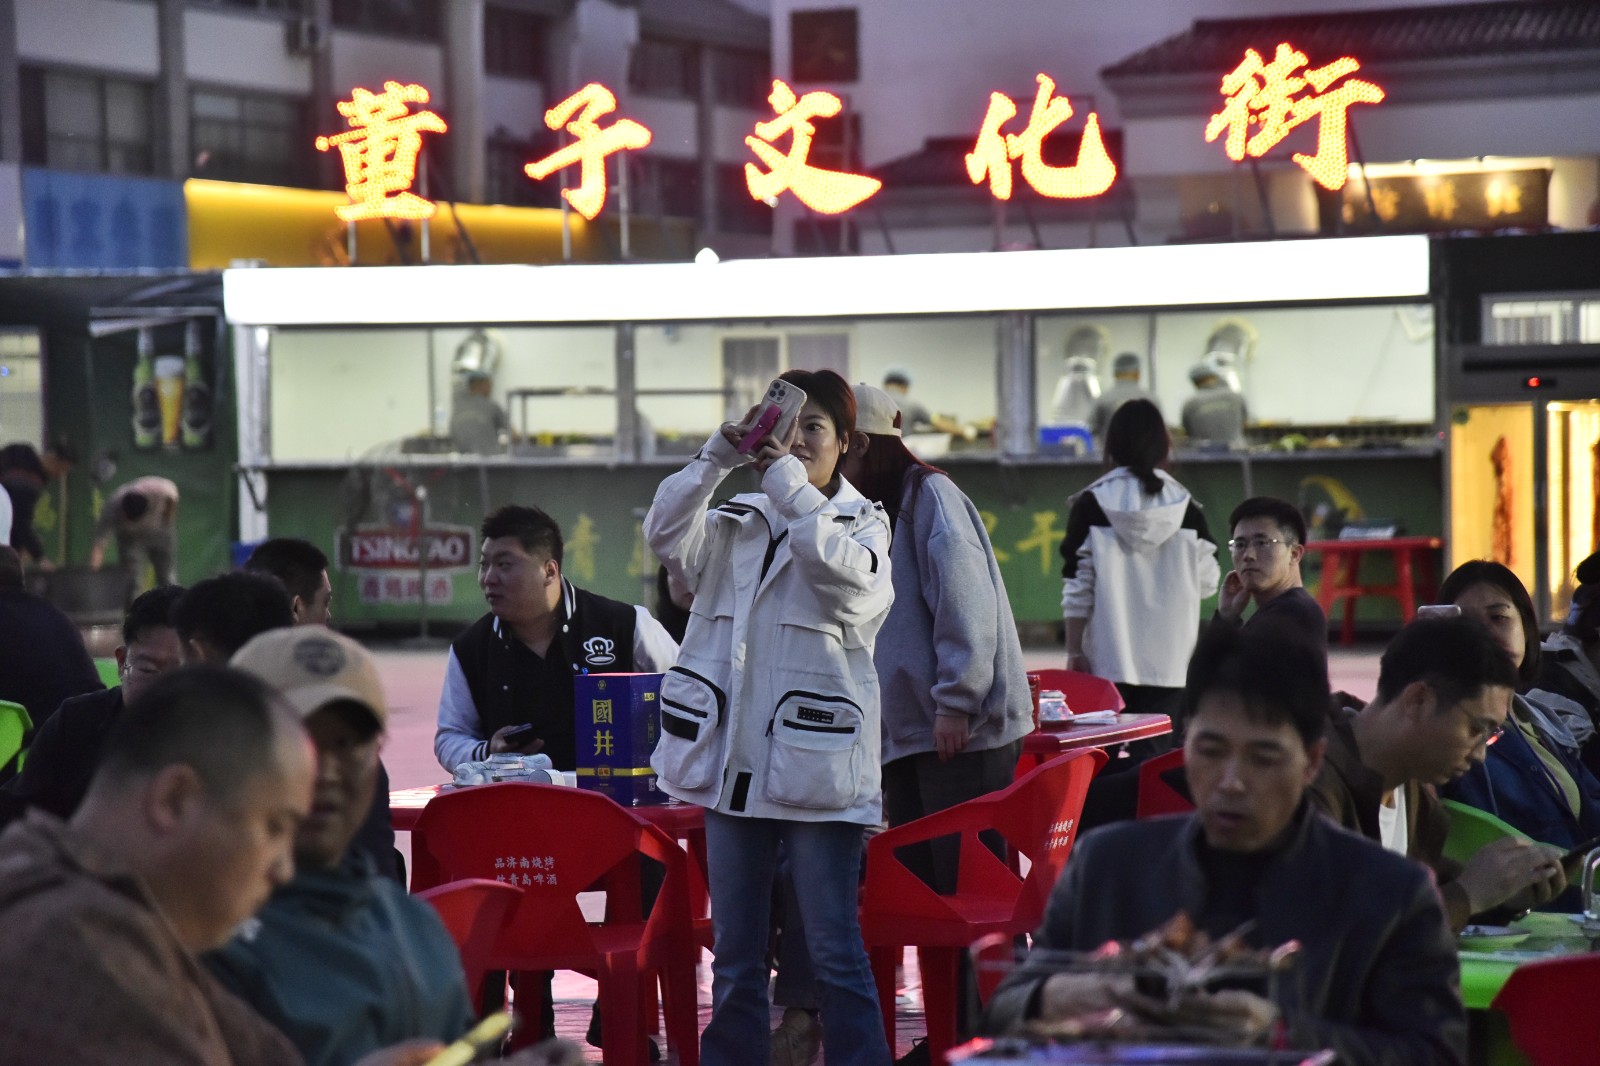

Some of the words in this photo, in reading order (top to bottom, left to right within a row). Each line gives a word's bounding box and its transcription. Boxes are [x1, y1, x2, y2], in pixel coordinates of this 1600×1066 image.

[495, 856, 555, 871] 品济南烧烤
